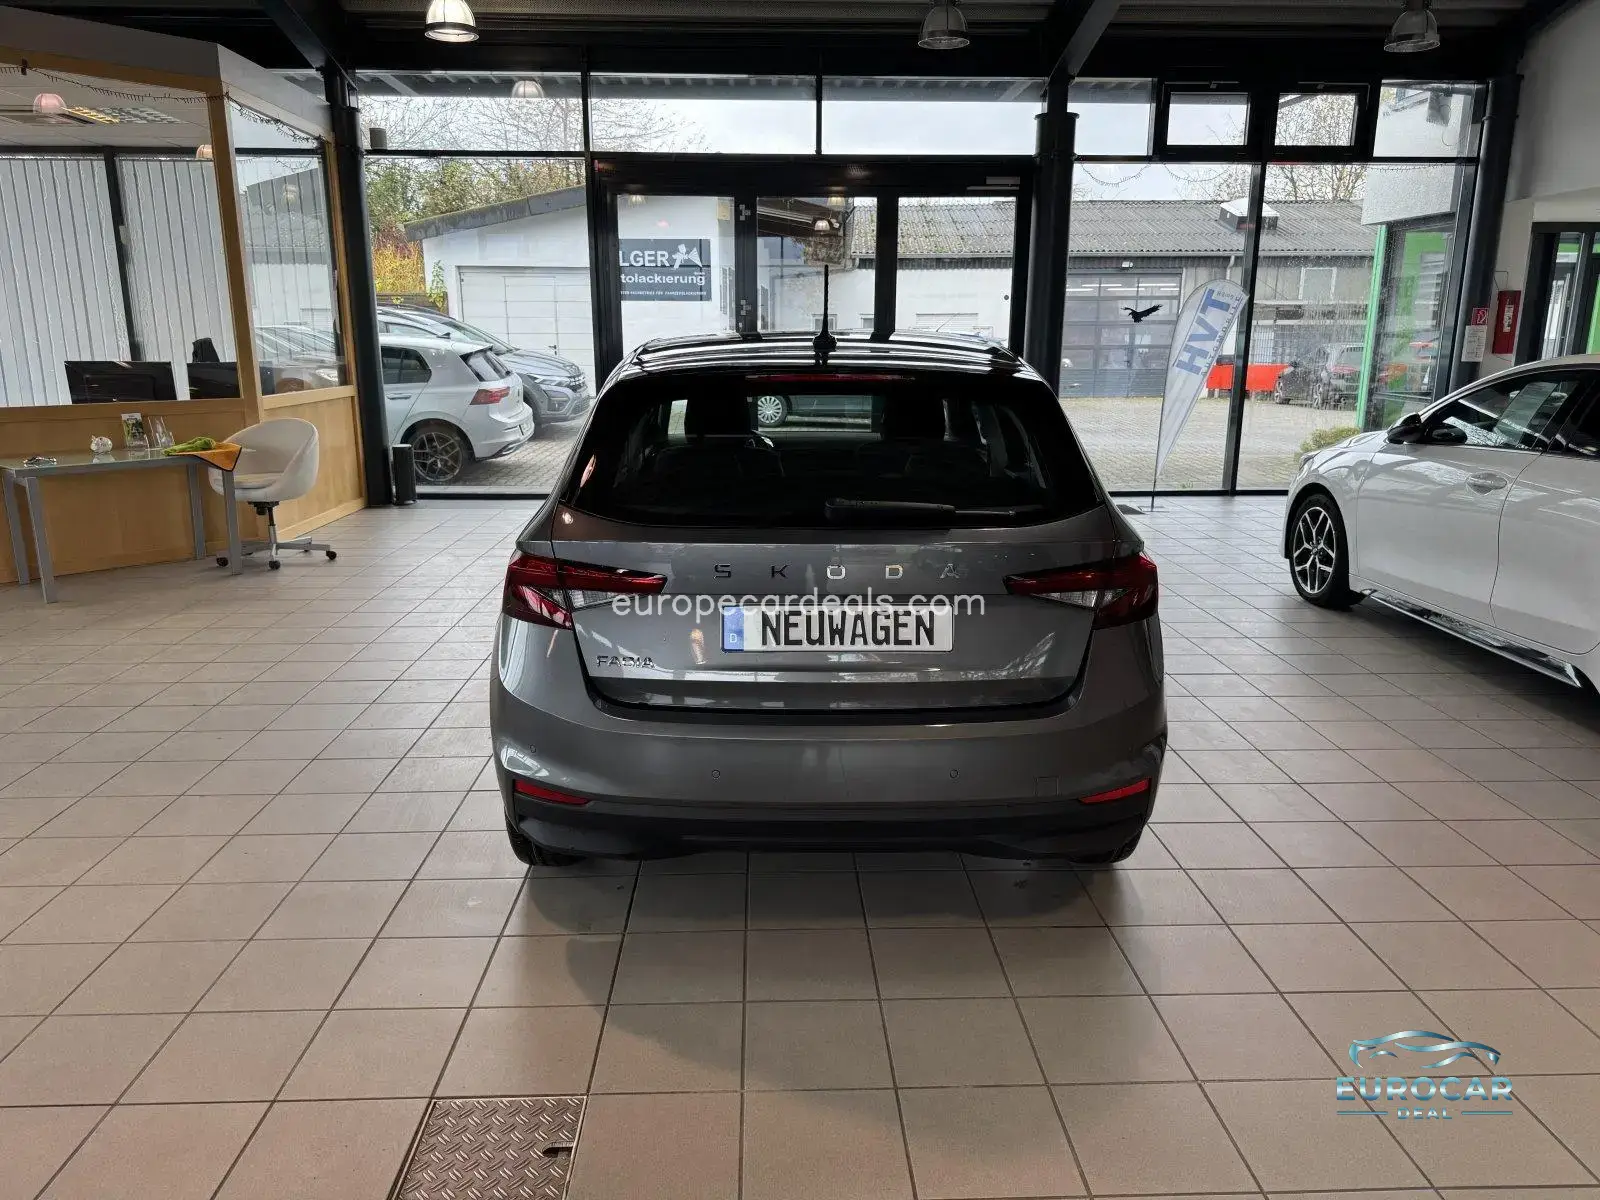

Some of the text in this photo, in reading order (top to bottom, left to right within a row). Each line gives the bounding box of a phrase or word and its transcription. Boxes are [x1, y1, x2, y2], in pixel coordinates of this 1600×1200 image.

[619, 250, 670, 267] LGER
[1174, 287, 1232, 376] HVT
[761, 609, 936, 646] NEUWAGEN
[596, 655, 655, 668] FABIA
